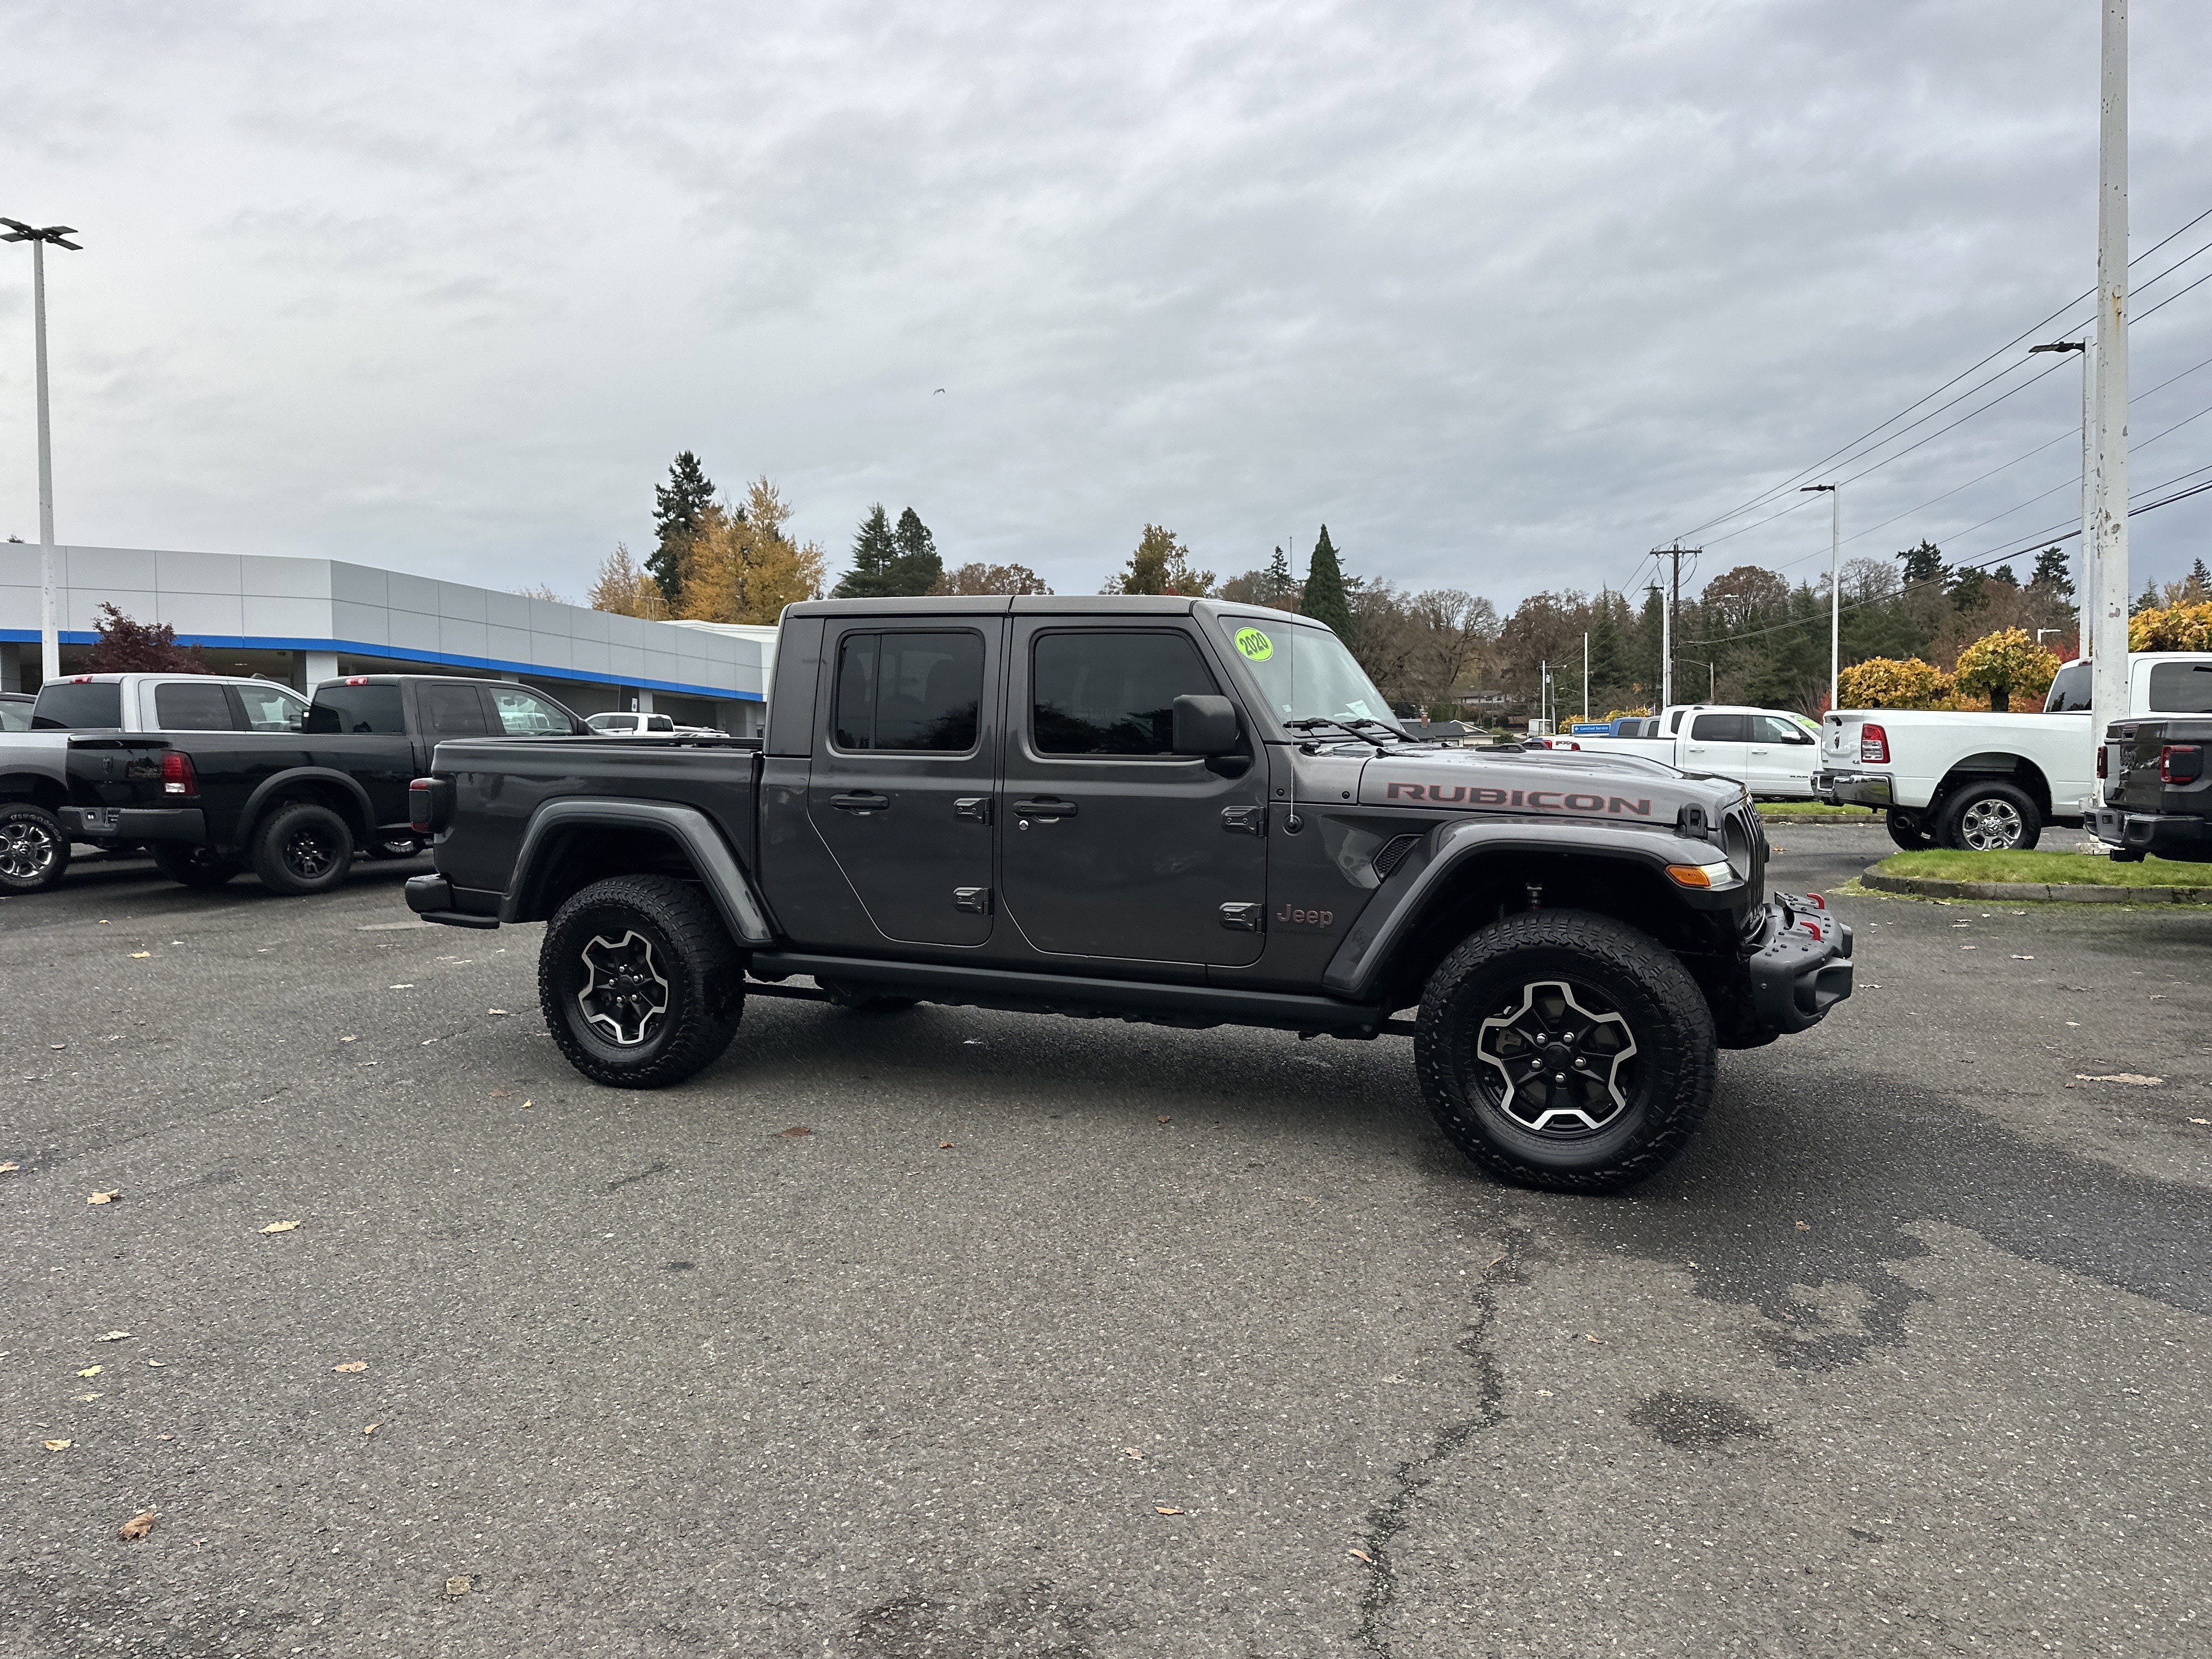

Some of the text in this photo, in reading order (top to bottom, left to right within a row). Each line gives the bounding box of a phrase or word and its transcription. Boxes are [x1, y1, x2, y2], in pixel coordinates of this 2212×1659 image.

[1239, 633, 1269, 656] 2020
[1386, 782, 1651, 816] RUBICON
[1277, 904, 1334, 929] Jeep
